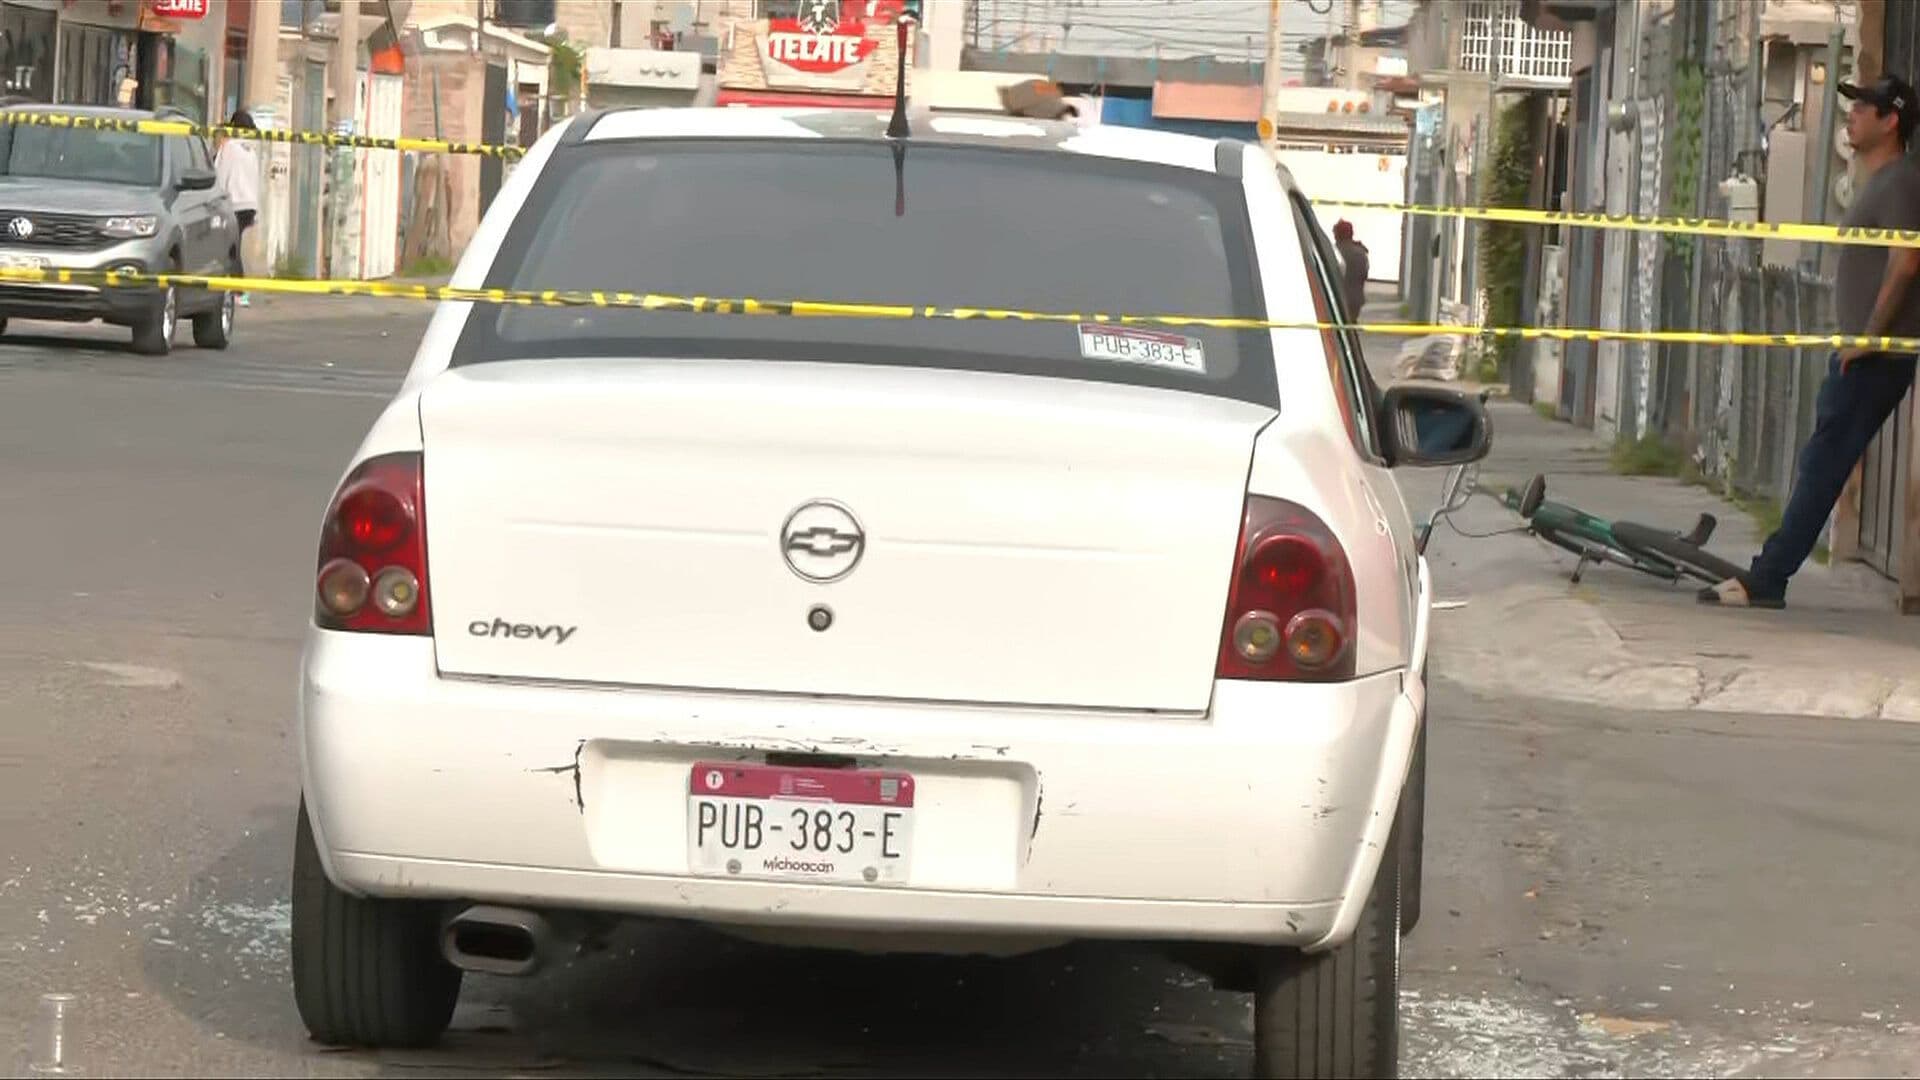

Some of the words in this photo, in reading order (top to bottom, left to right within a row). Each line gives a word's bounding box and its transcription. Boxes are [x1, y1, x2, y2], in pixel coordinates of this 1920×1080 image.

[769, 31, 863, 63] TECATE
[1092, 335, 1194, 365] PUB-383-E
[468, 617, 578, 645] chevy
[698, 802, 902, 858] PUB-383-E
